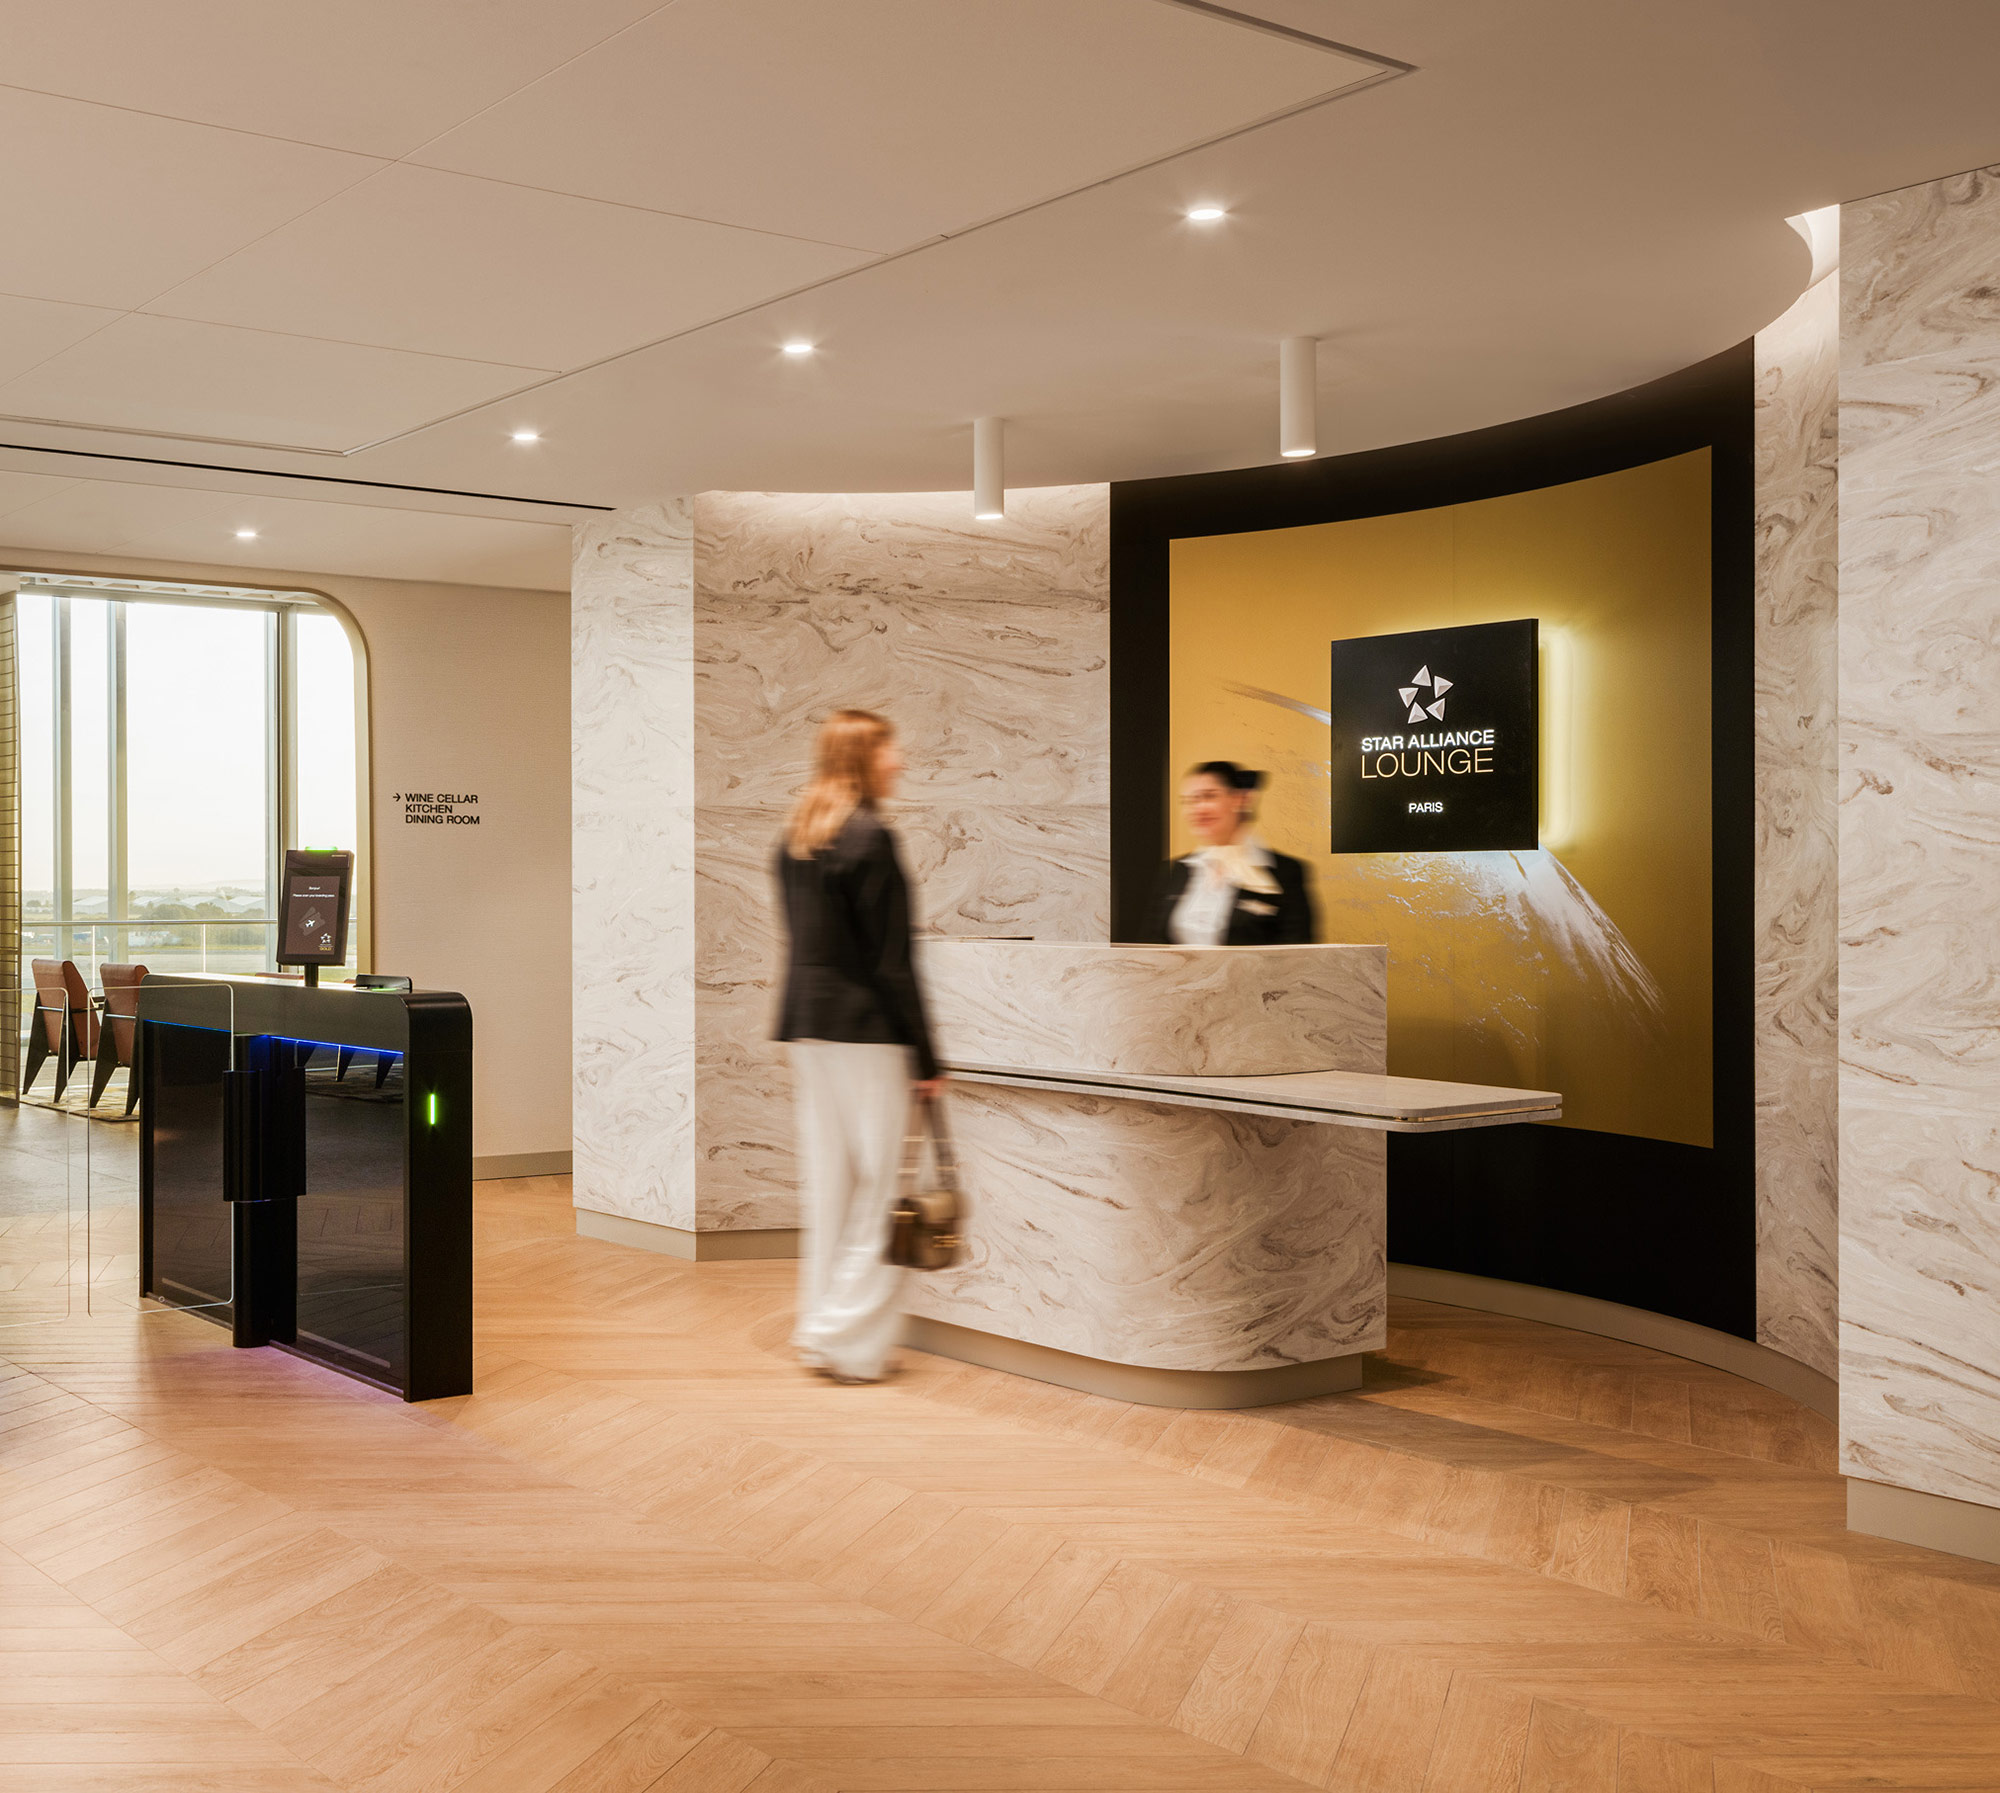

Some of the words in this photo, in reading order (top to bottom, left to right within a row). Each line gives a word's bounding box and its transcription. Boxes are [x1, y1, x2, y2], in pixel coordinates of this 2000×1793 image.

[1361, 735, 1404, 752] STAR
[1407, 729, 1495, 749] ALLIANCE
[1361, 747, 1494, 779] LOUNGE
[405, 793, 434, 803] WINE
[436, 794, 478, 804] CELLAR
[405, 804, 453, 814] KITCHEN
[1408, 801, 1444, 814] PARIS
[405, 814, 444, 824] DINING
[446, 815, 480, 825] ROOM
